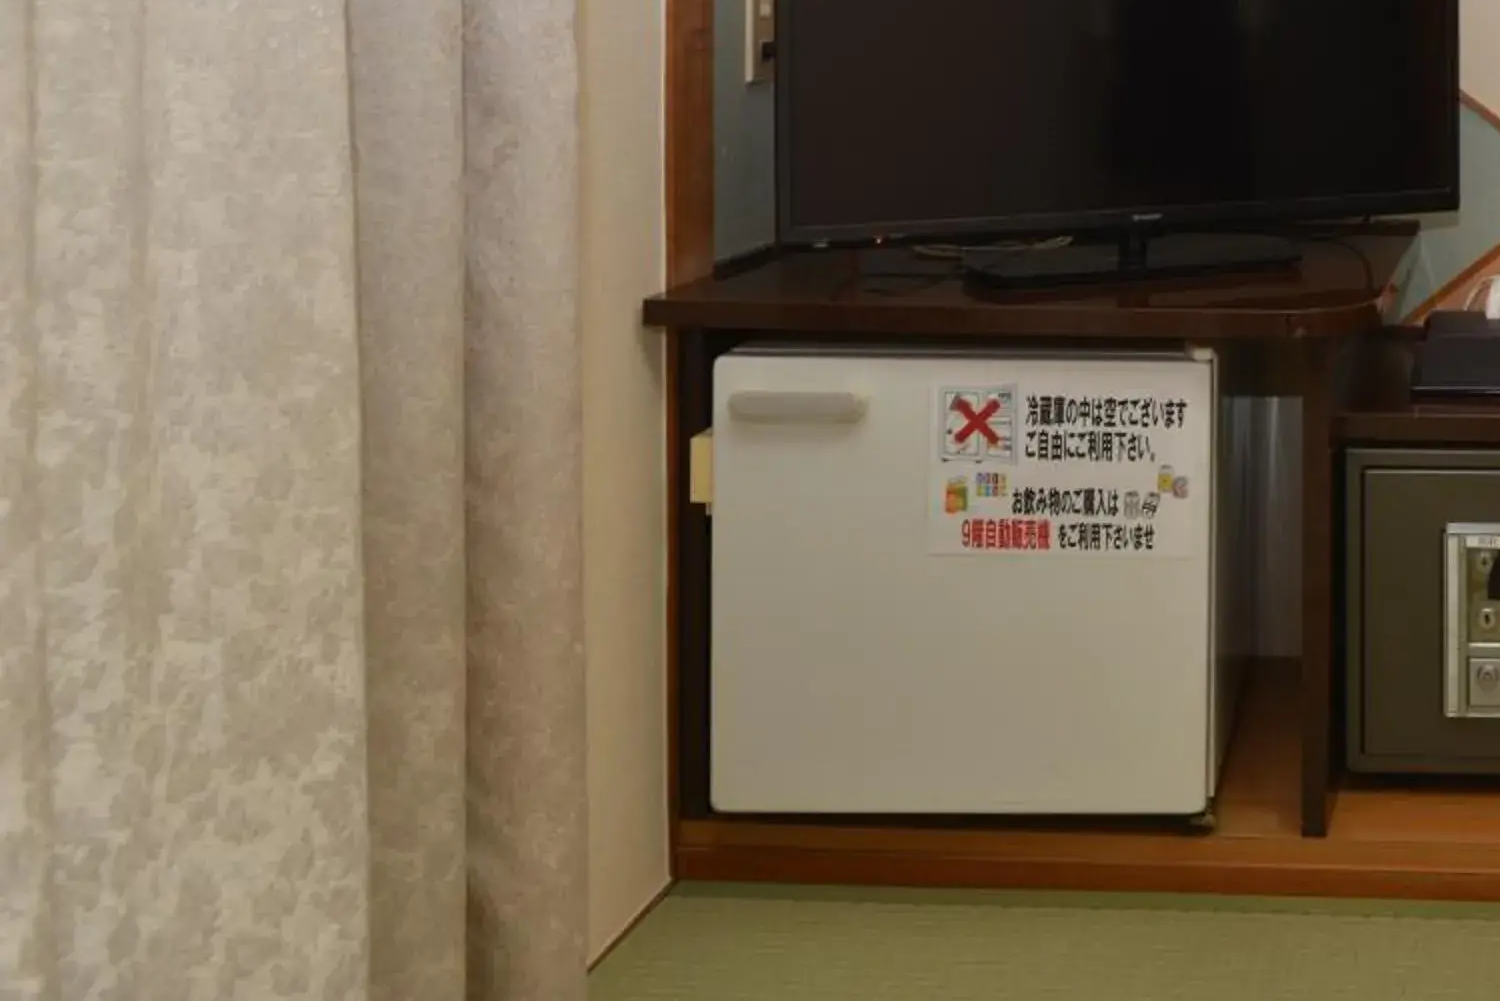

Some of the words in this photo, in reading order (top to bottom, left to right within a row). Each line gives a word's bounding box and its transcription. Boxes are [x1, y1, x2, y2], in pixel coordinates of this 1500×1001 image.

[1025, 395, 1188, 429] 冷蔵庫の中は空でございます
[1011, 486, 1119, 516] お飲み物のご購入は
[1057, 521, 1155, 550] をご利用下さいませ
